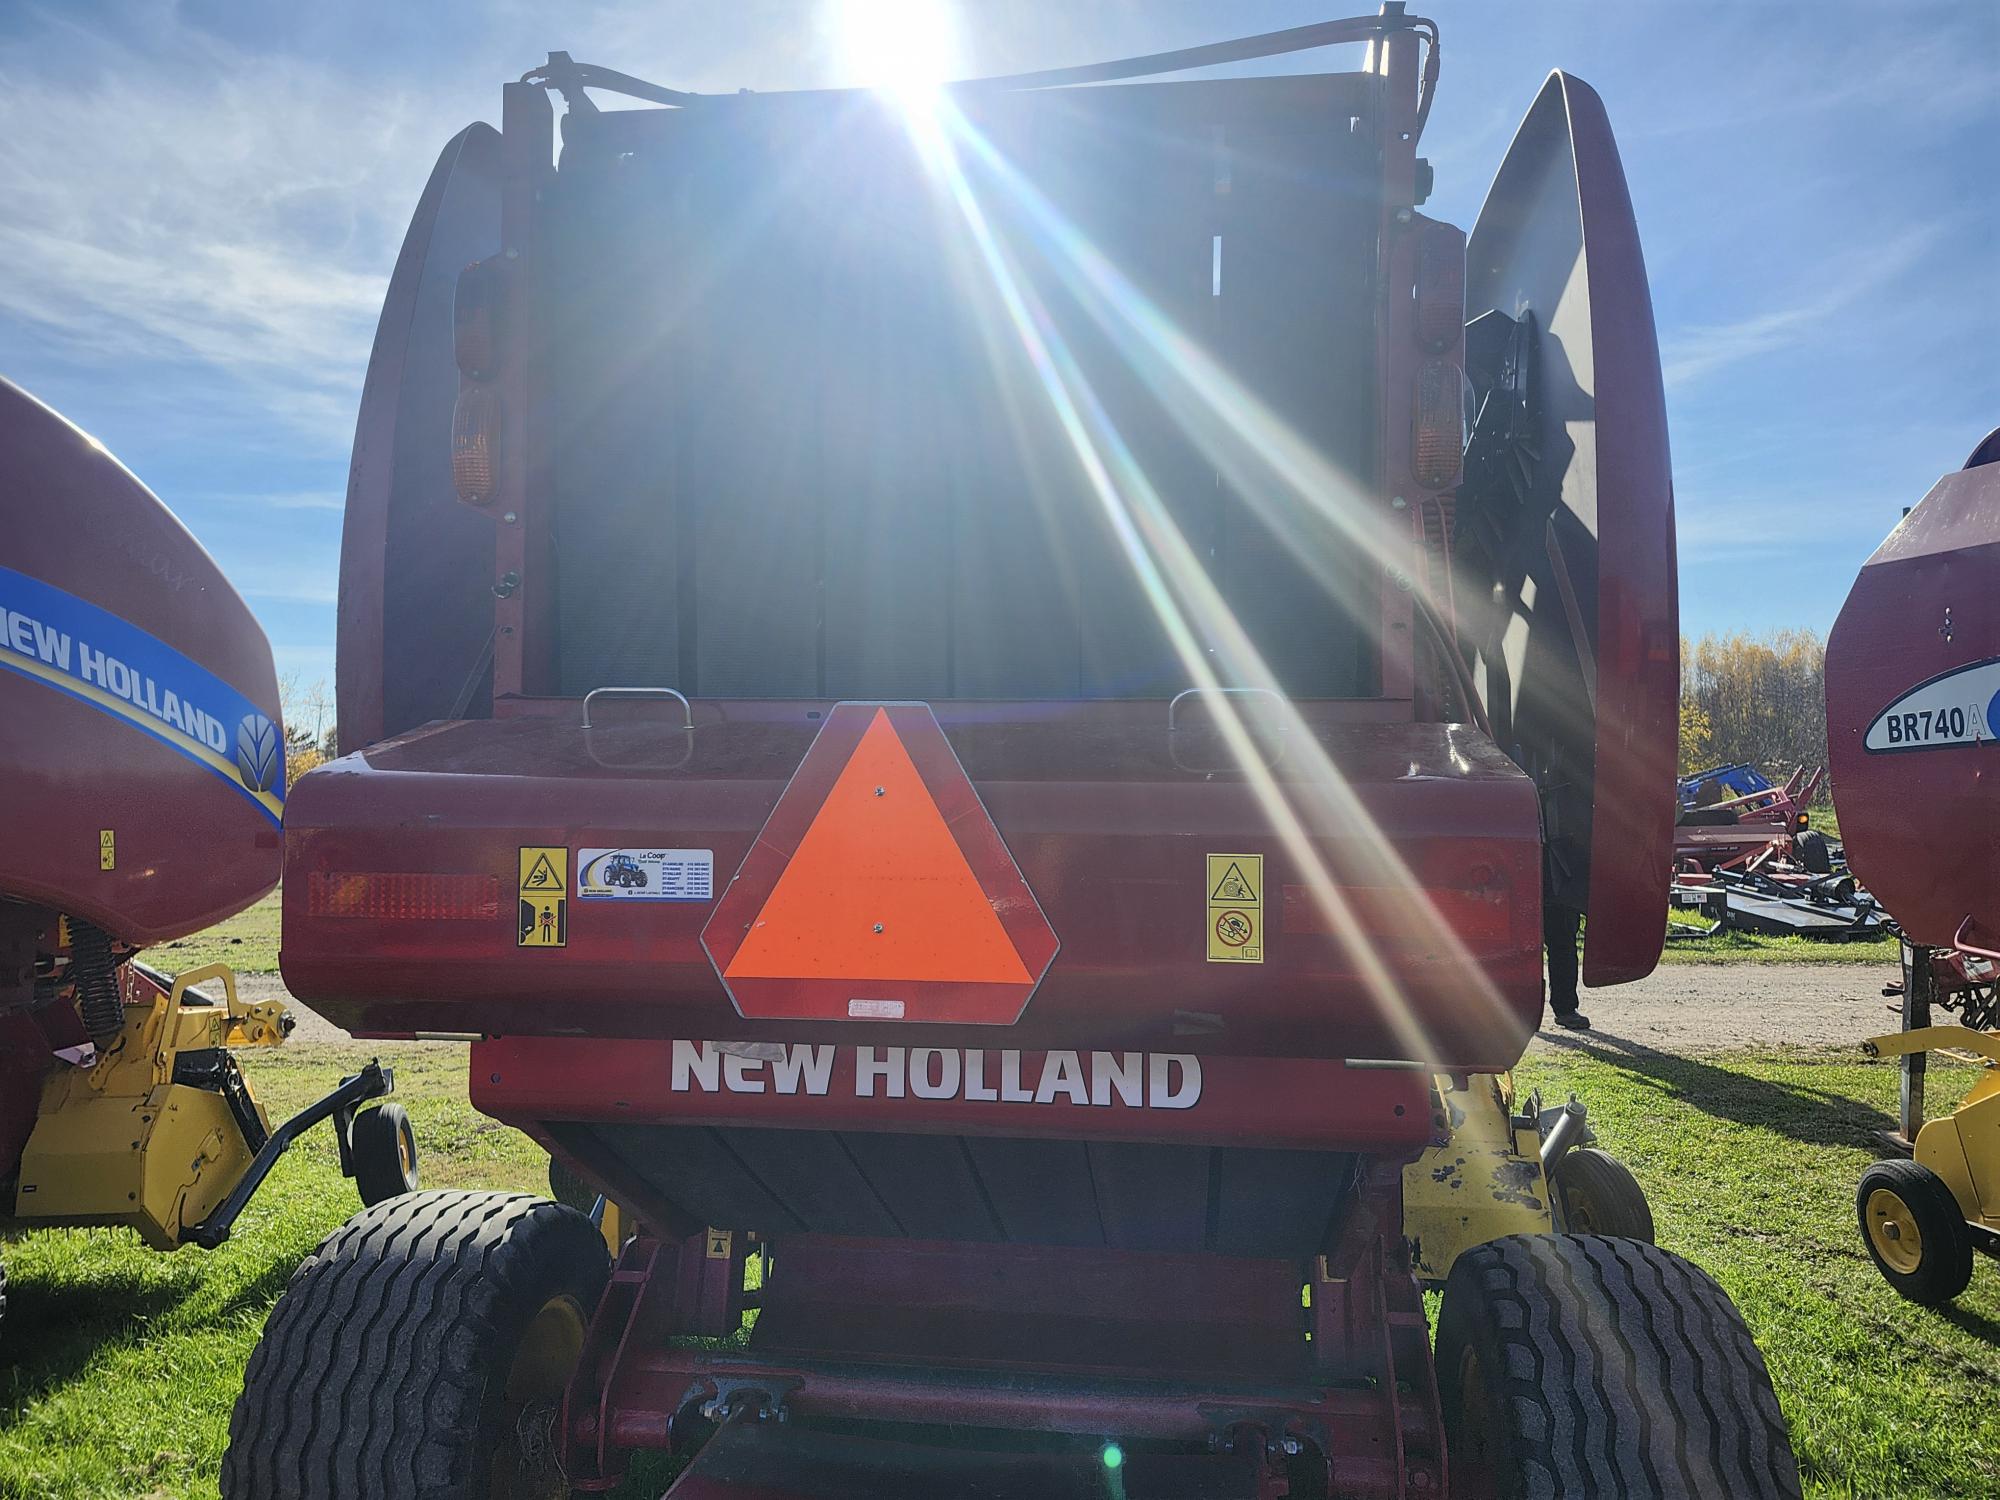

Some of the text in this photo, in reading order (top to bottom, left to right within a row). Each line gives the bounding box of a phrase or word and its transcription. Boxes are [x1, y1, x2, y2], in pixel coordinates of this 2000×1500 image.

[79, 641, 227, 754] HOLLAND
[1887, 703, 1986, 743] BR740A
[647, 851, 666, 860] Coop
[671, 1039, 1202, 1109] NEW HOLLAND
